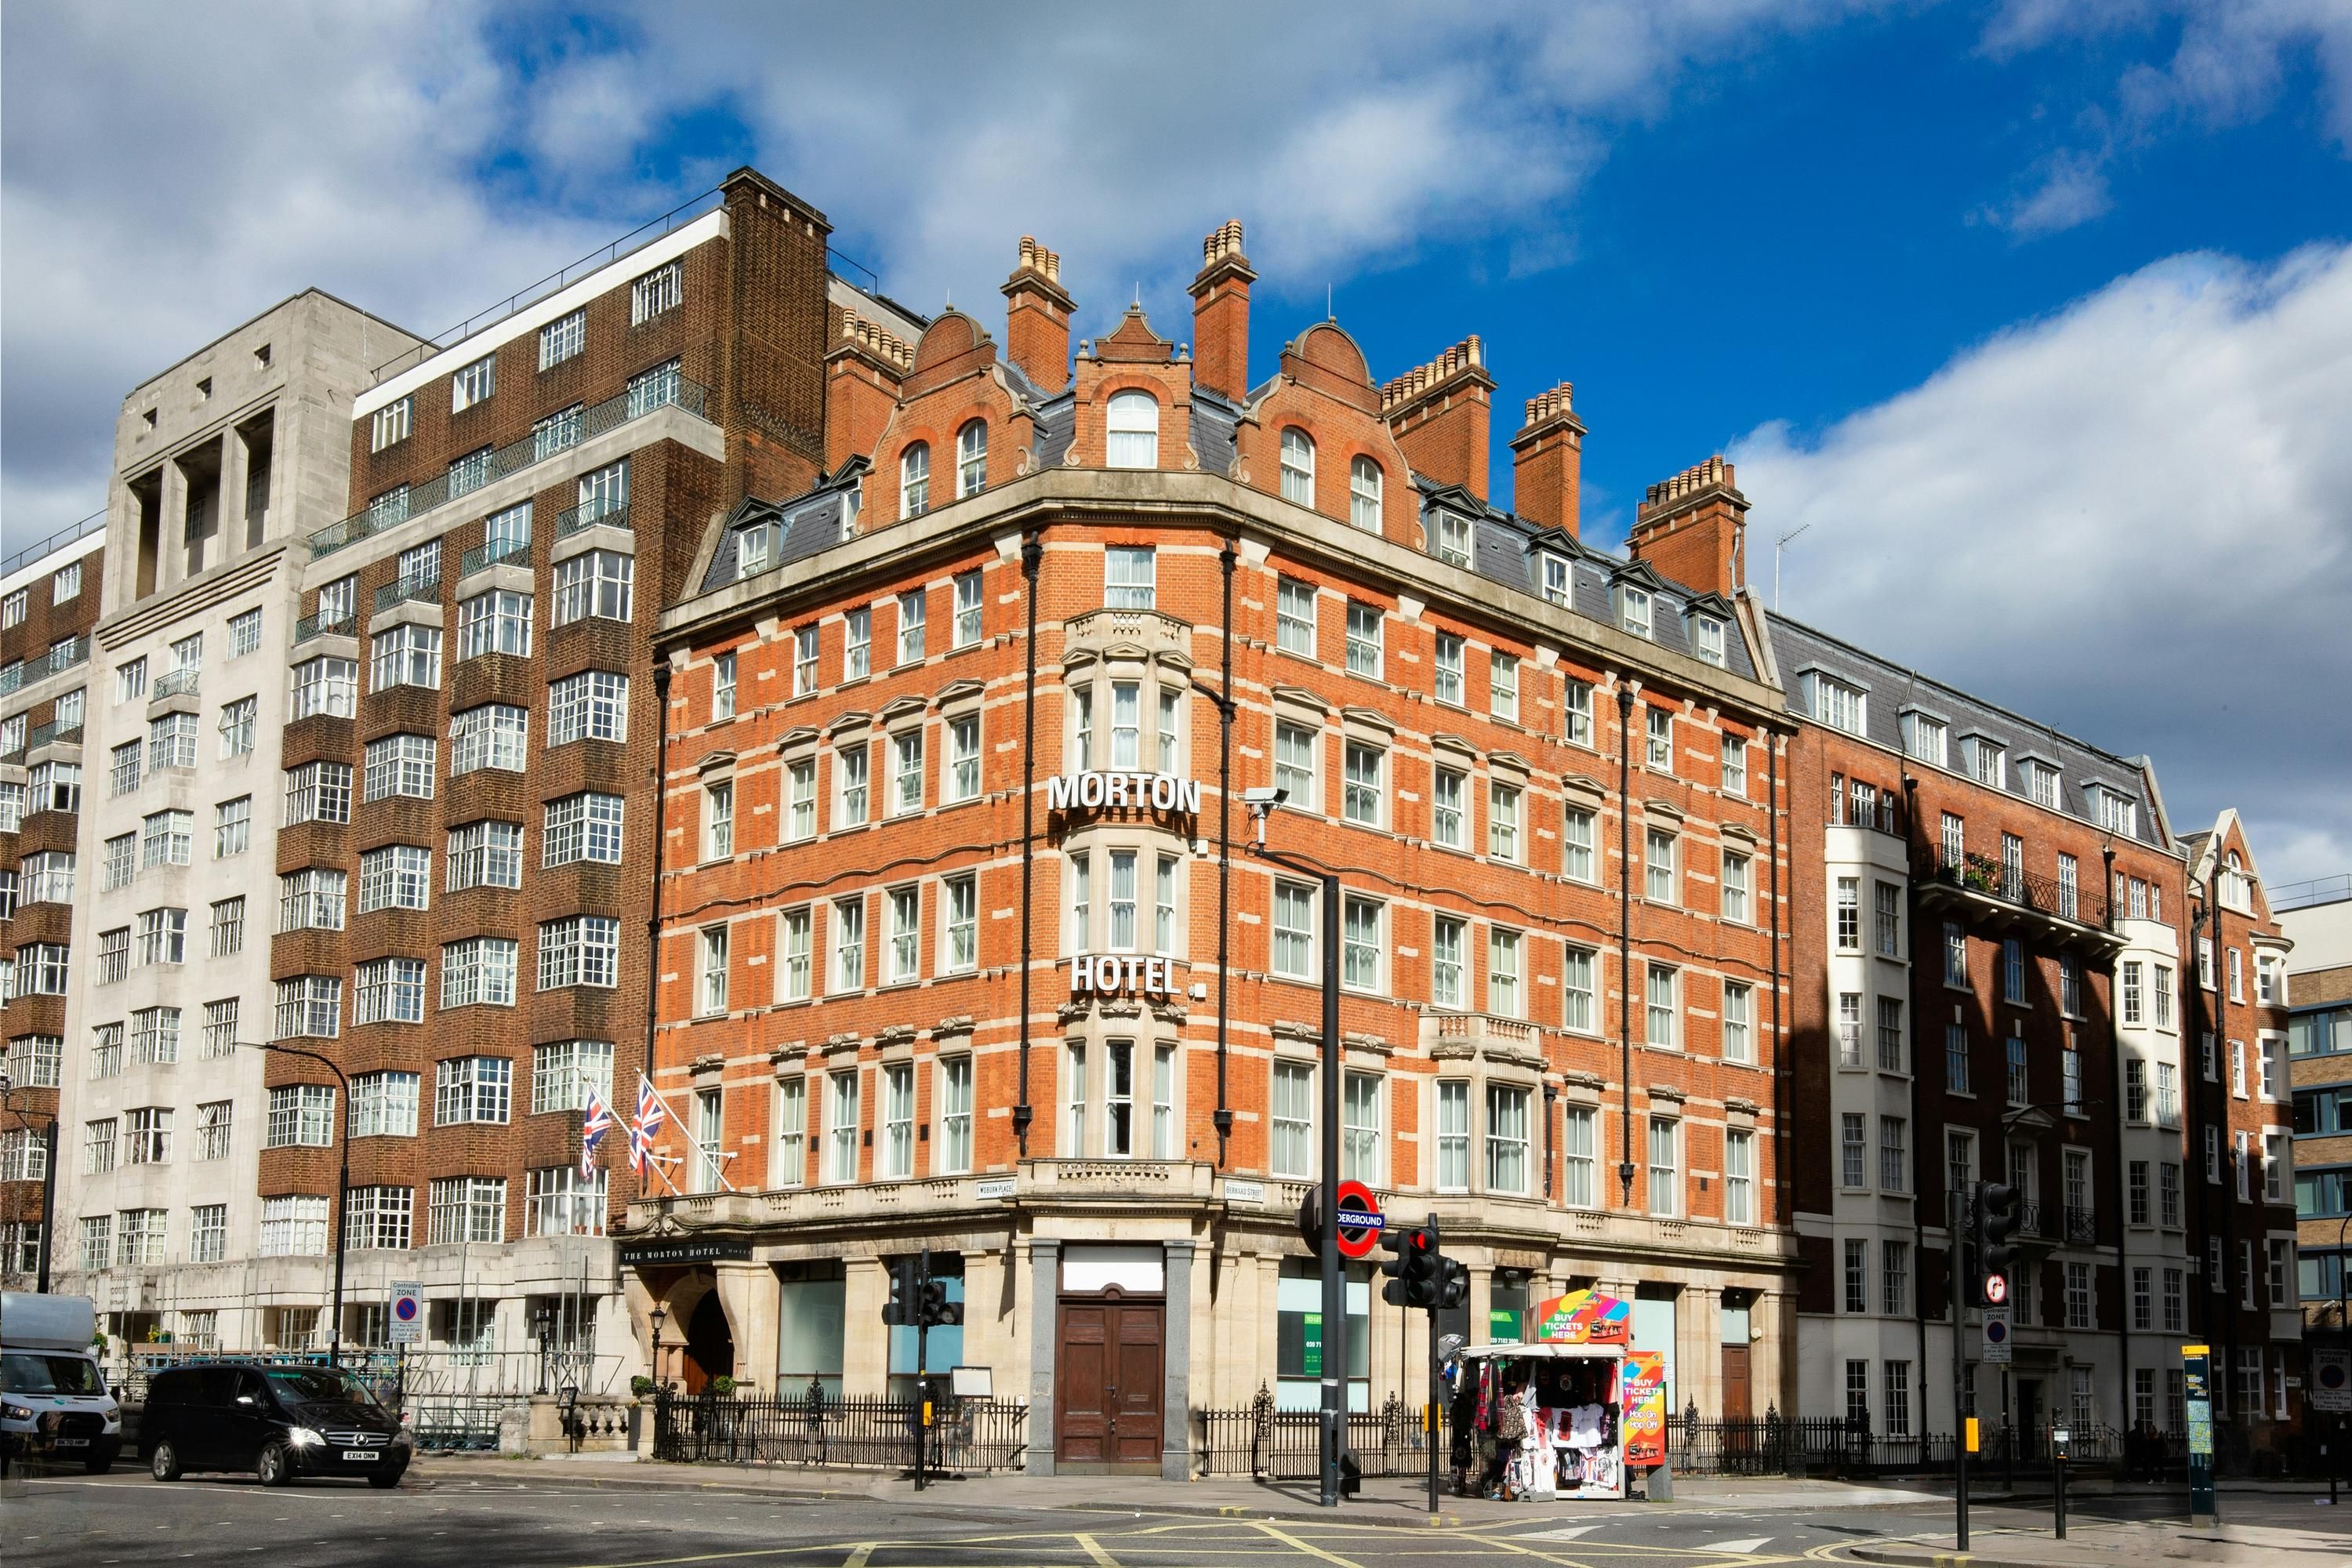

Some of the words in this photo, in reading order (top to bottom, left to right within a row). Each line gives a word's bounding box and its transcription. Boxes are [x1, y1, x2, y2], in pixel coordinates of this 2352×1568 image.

[1047, 773, 1201, 814] MORTON
[1071, 956, 1181, 994] HOTEL
[1247, 1188, 1262, 1196] STREET
[1338, 1214, 1382, 1225] DERGROUND
[647, 1250, 684, 1260] MORTON
[689, 1247, 720, 1257] HOTEL
[1629, 1410, 1644, 1419] Hop
[1629, 1421, 1644, 1430] Hop
[1646, 1421, 1658, 1429] Off
